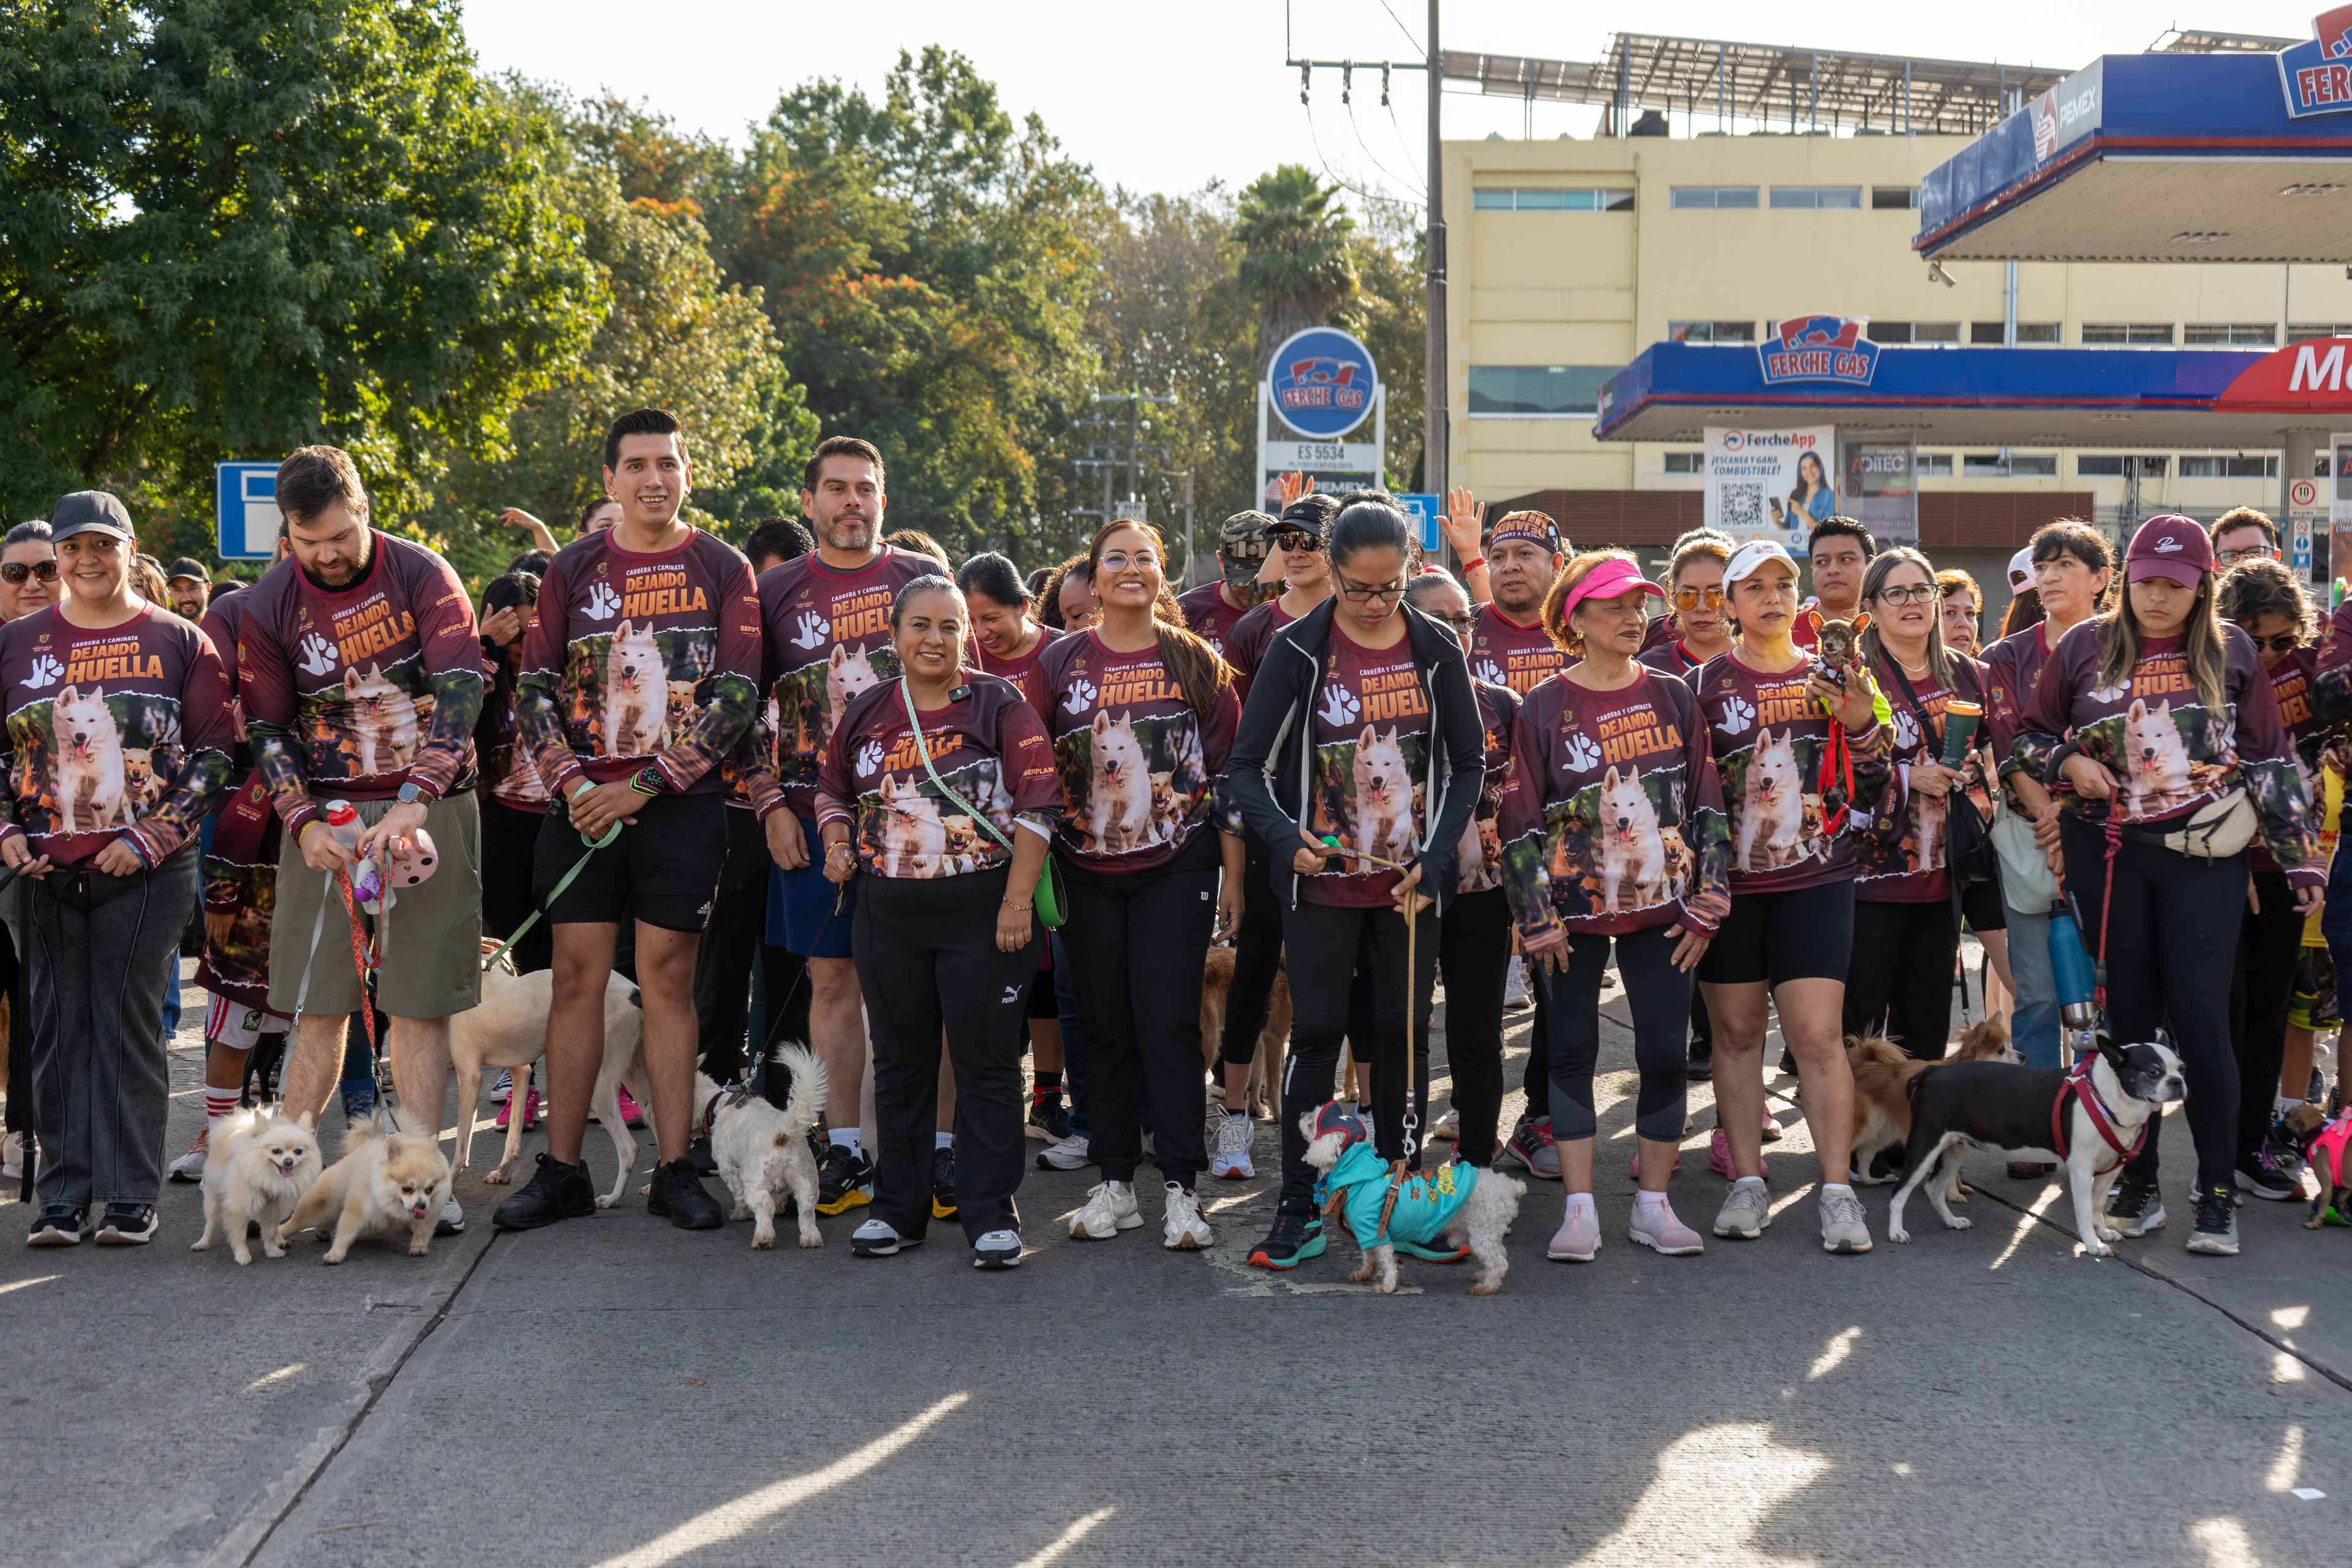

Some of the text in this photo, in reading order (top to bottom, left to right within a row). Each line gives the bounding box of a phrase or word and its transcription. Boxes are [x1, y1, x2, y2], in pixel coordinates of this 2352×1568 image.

[2297, 63, 2352, 107] FER
[2060, 85, 2095, 129] PEMEX
[1768, 351, 1870, 378] FERCHE GAS
[2288, 344, 2352, 392] M
[1283, 387, 1363, 409] FERCHE GAS
[1747, 432, 1816, 448] FercheApp
[1298, 445, 1344, 460] ES 5534
[1757, 456, 1778, 464] GANA
[1714, 464, 1781, 475] COMBUSTIBLE!
[2299, 487, 2309, 497] 10
[1492, 520, 1547, 540] DEJANDO
[625, 572, 687, 593] DEJANDO
[626, 567, 651, 576] CARRERA
[622, 586, 707, 618] HUELLA
[831, 591, 856, 602] CARRERA
[862, 584, 889, 594] CAMINATA
[832, 591, 892, 617] DEJANDO
[332, 608, 356, 621] CARRERA
[361, 592, 385, 608] CAMINATA
[334, 600, 390, 638] DEJANDO
[832, 606, 894, 643] HUEL
[72, 637, 100, 647] CARRERA
[339, 610, 417, 666] HUELLA
[70, 642, 140, 662] DEJANDO
[1508, 654, 1564, 670] DEJANDO
[65, 655, 164, 684] HUELLA
[1102, 668, 1164, 685] DEJANDO
[1360, 667, 1385, 676] CARRERA
[1391, 662, 1415, 671] CAMINAT
[1098, 681, 1183, 708] HUELLA
[1757, 685, 1806, 701] DEJAND
[2133, 673, 2195, 698] HUEL
[1597, 711, 1621, 723] CARRERA
[1627, 703, 1652, 714] CAMINATA
[1599, 710, 1657, 739] DEJANDO
[1602, 724, 1683, 764] HUELLA
[1886, 789, 1894, 815] VERACRUZ
